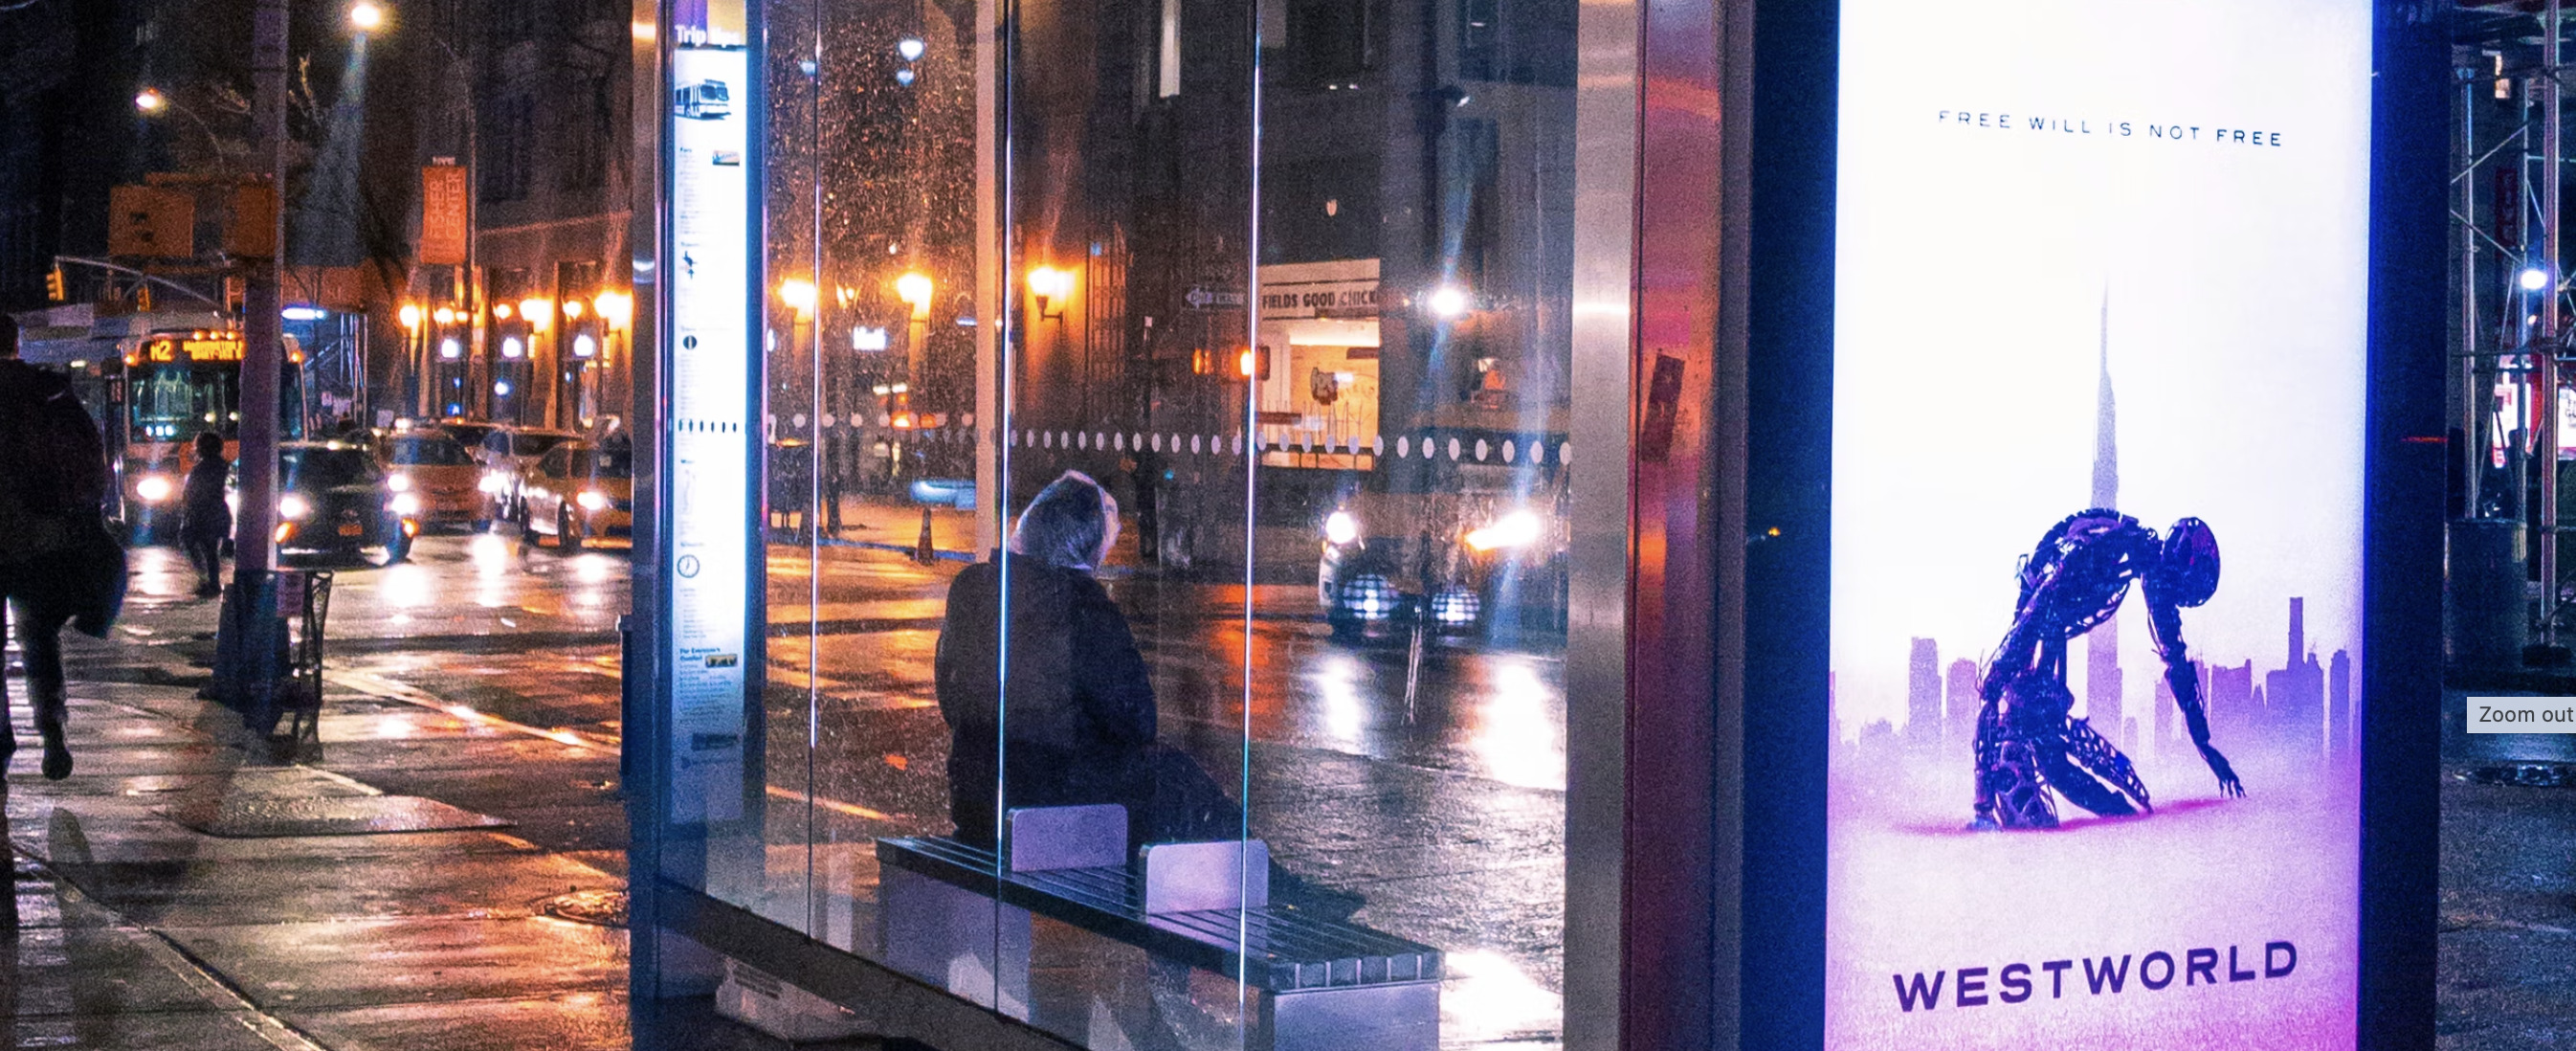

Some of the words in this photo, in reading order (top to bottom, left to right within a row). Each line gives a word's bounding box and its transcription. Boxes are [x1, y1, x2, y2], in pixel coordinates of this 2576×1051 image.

[674, 24, 707, 47] Trip
[1938, 110, 2010, 128] FREE
[2029, 116, 2091, 134] WILL
[2108, 122, 2132, 137] IS
[2149, 124, 2200, 140] NOT
[2216, 128, 2281, 146] FREE
[429, 180, 445, 239] FISHER
[445, 172, 461, 240] CENTER
[1262, 294, 1299, 309] FIELDS
[1302, 292, 1336, 307] GOOD
[1892, 940, 2297, 1013] WESTWORLD
